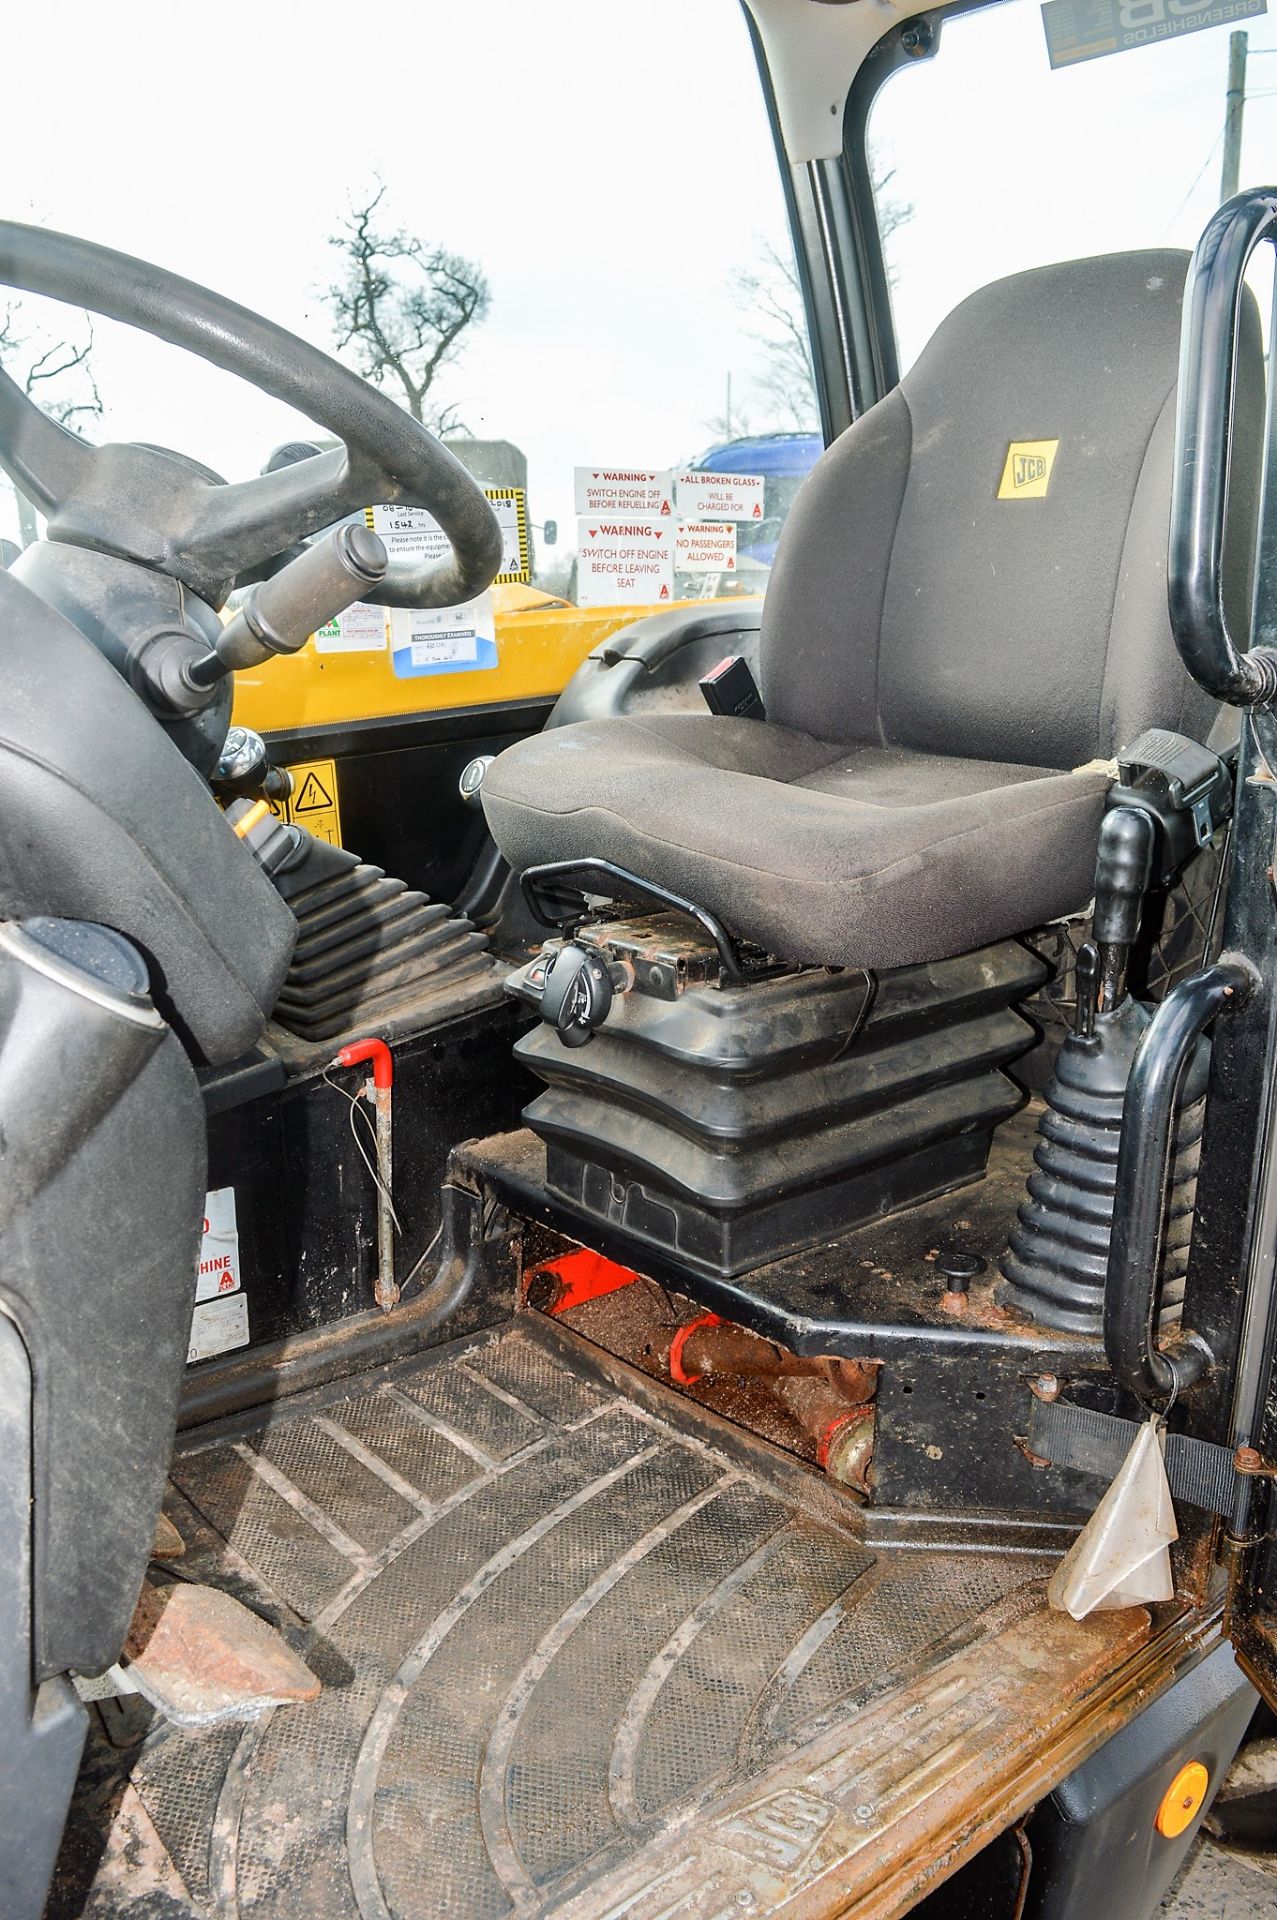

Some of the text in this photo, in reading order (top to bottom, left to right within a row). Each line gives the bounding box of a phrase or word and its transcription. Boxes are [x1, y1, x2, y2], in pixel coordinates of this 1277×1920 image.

[1016, 457, 1044, 485] JCB
[602, 472, 647, 482] WARNING
[685, 476, 756, 486] ALL BROKEN GLASS
[587, 488, 661, 498] SWITCH ENGINE OFF
[708, 492, 733, 501] WILL BE
[589, 500, 660, 509] BEFORE REFUELLING
[697, 502, 744, 511] CHARGED FOR
[600, 525, 652, 536] WARNING
[687, 525, 724, 533] WARNING
[676, 539, 735, 549] NO PASSENGERS
[582, 548, 669, 560] SWITCH OFF ENGINE
[687, 552, 725, 561] ALLOWED
[592, 563, 660, 574] BEFORE LEAVING
[617, 578, 636, 588] SEAT
[722, 1794, 830, 1868] JCB
